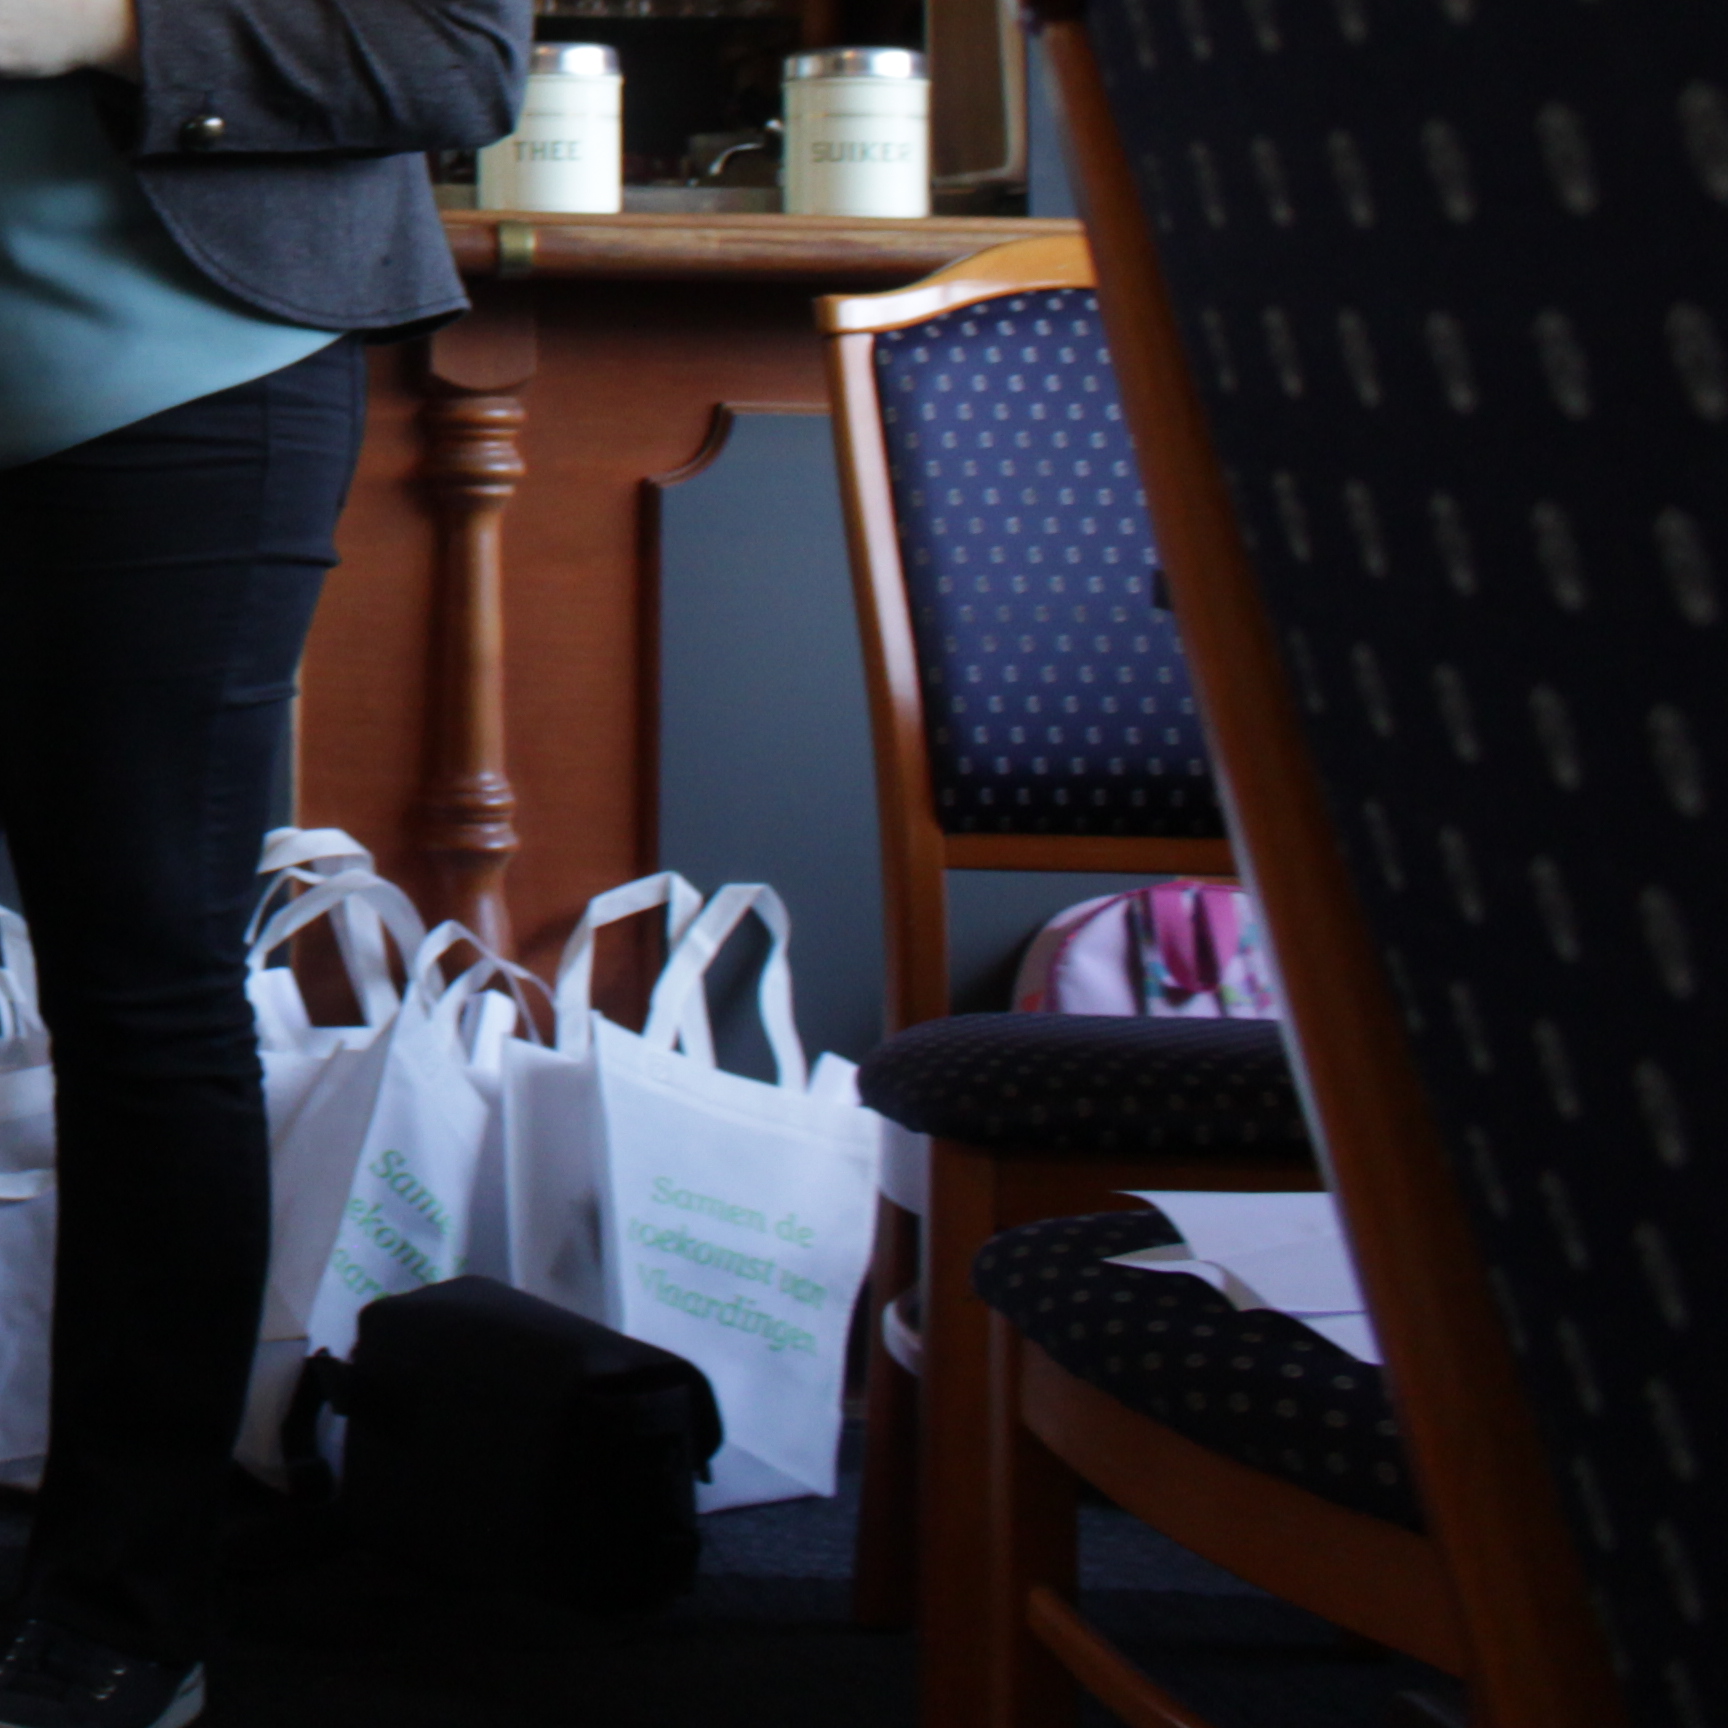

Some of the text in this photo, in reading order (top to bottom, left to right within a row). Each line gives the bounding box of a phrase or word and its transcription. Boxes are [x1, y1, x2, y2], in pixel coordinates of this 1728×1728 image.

[512, 139, 582, 162] THEE
[812, 141, 912, 163] SUIKER
[650, 1175, 817, 1249] Samen de
